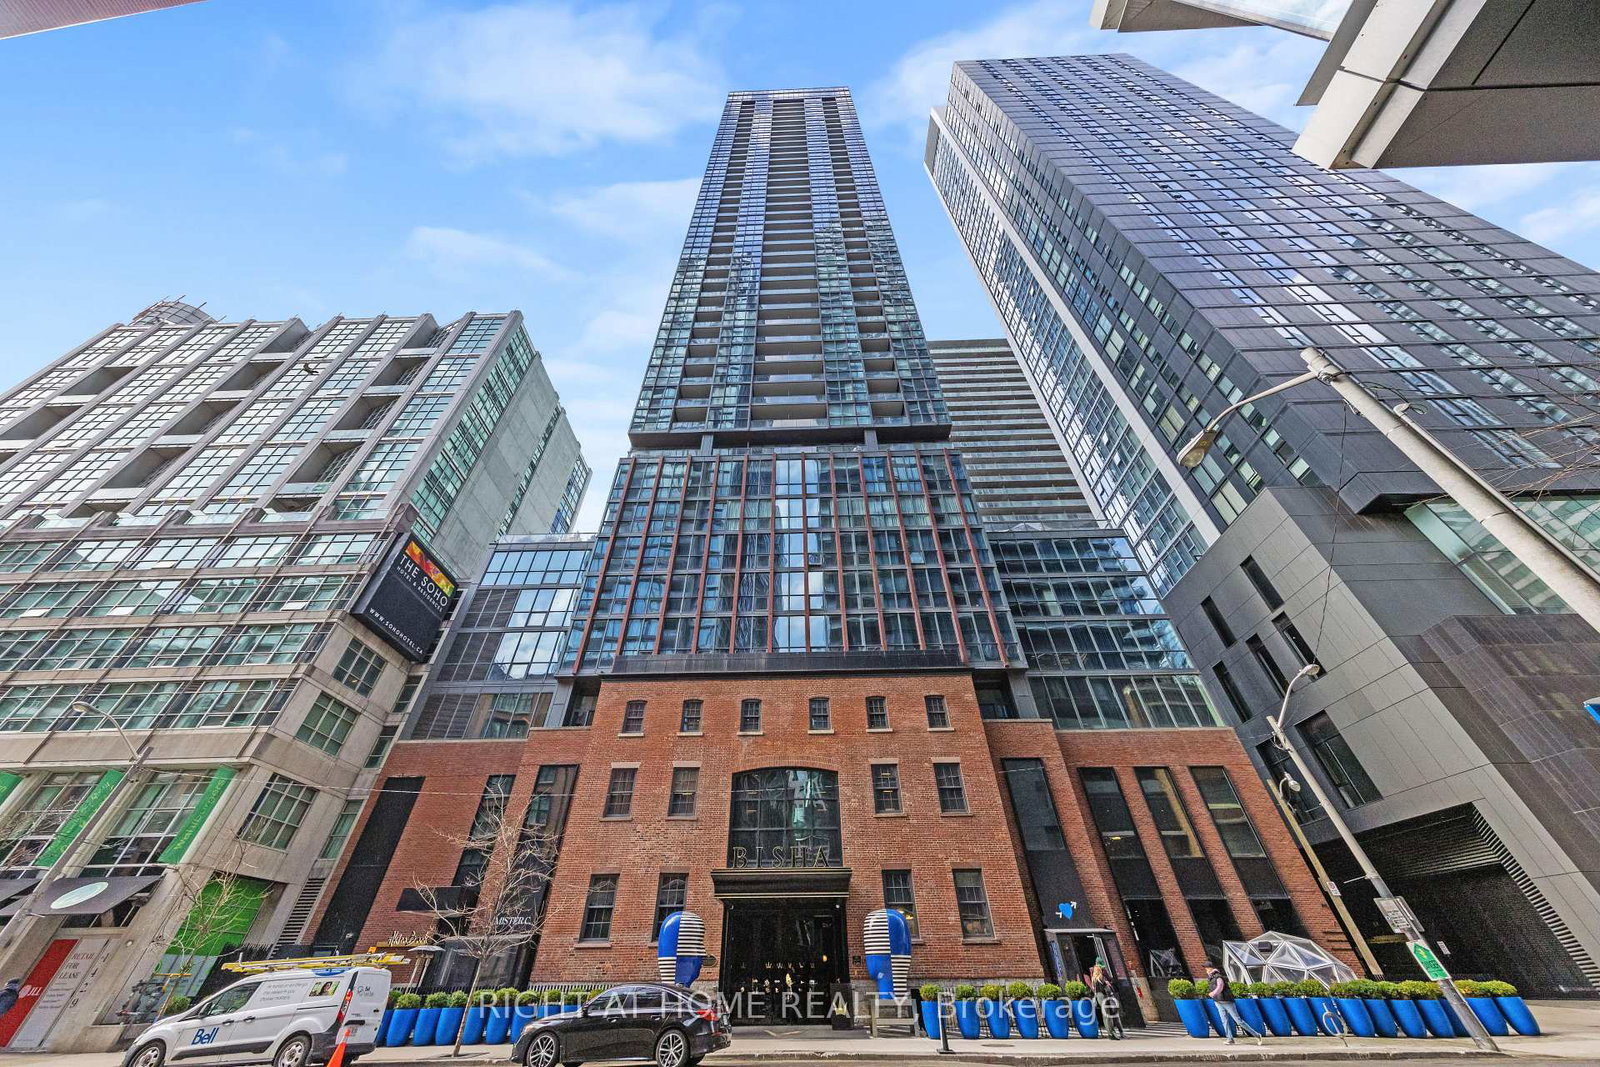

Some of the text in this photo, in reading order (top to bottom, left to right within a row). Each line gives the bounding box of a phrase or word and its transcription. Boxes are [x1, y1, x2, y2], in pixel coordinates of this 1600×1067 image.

[397, 566, 412, 582] HOTEL
[418, 586, 443, 612] RESIDENCES
[401, 554, 448, 606] THE SOHO
[732, 846, 830, 868] BISHA
[27, 987, 43, 997] JLL
[191, 1027, 219, 1045] Bell
